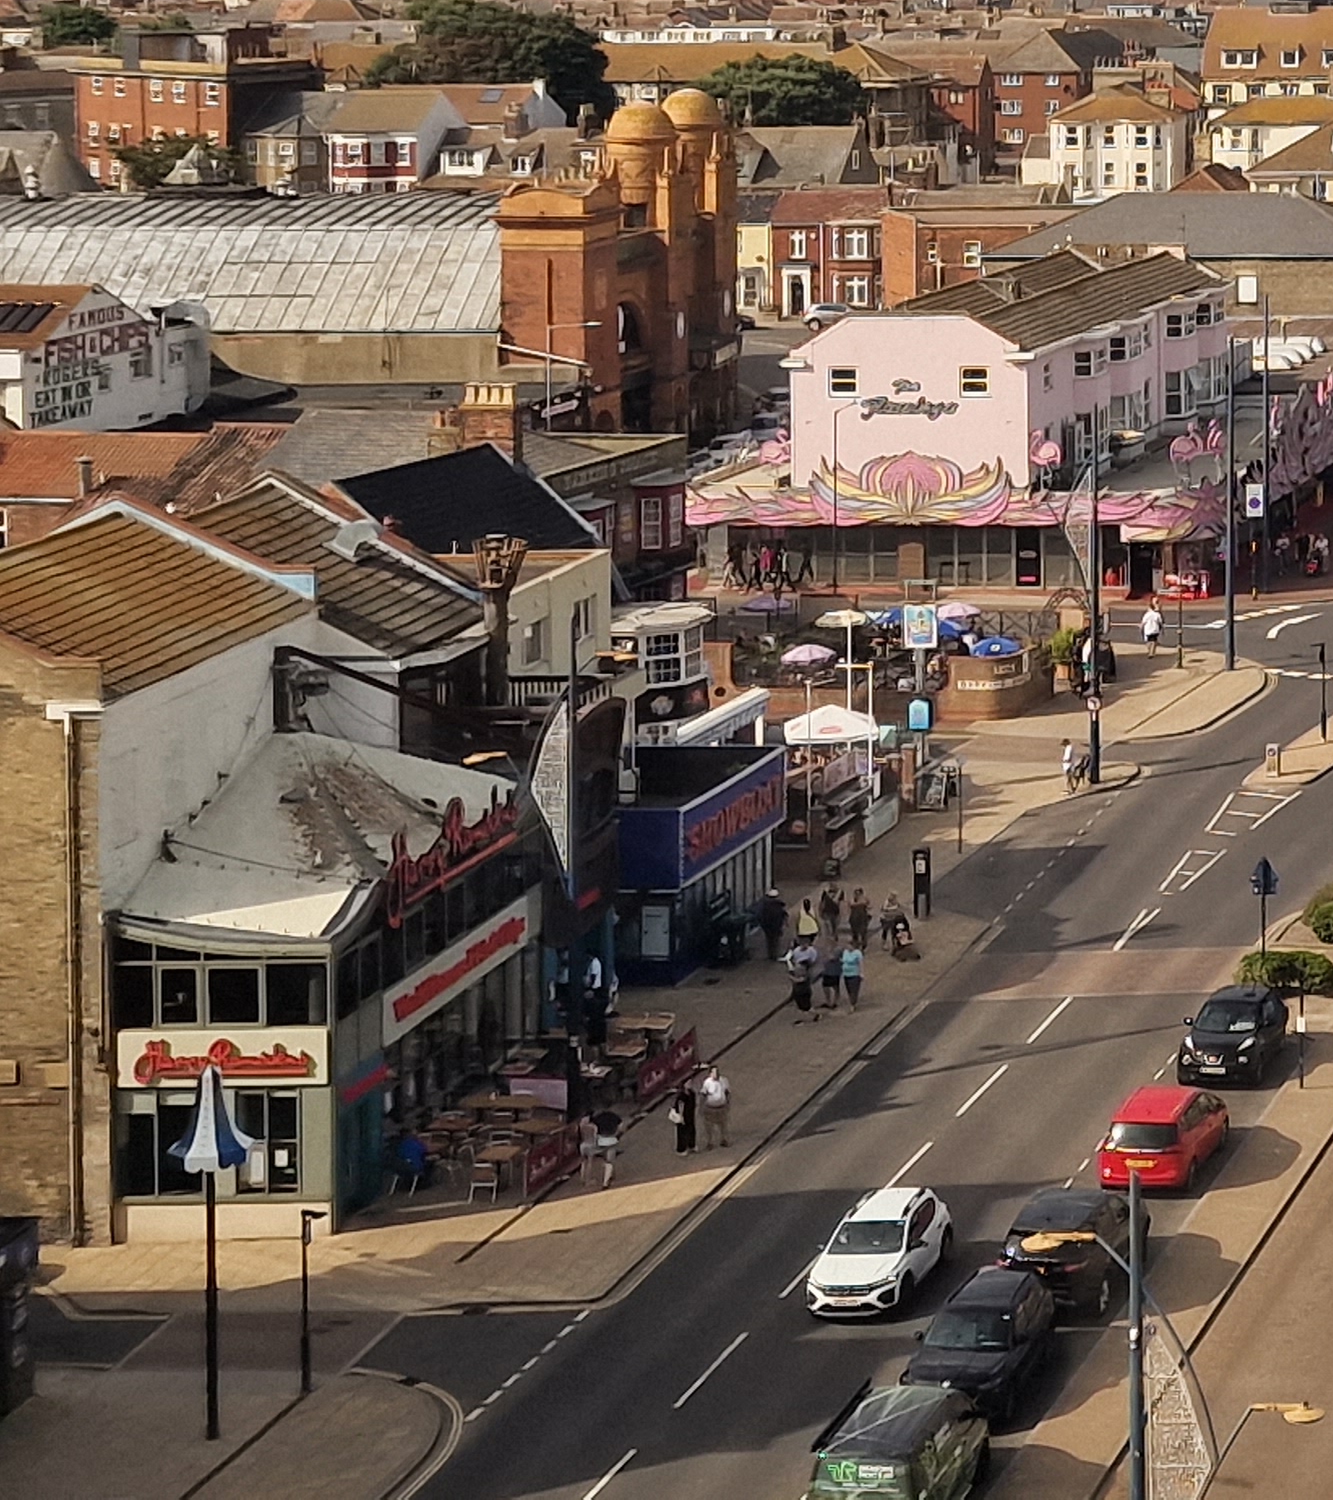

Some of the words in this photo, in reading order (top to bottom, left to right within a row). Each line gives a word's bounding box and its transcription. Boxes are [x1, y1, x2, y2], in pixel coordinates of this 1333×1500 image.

[68, 305, 125, 332] FAMOUS
[44, 333, 86, 369] FISH
[35, 389, 57, 409] EAT
[75, 381, 92, 399] OR
[29, 401, 93, 429] TAKEAWAY
